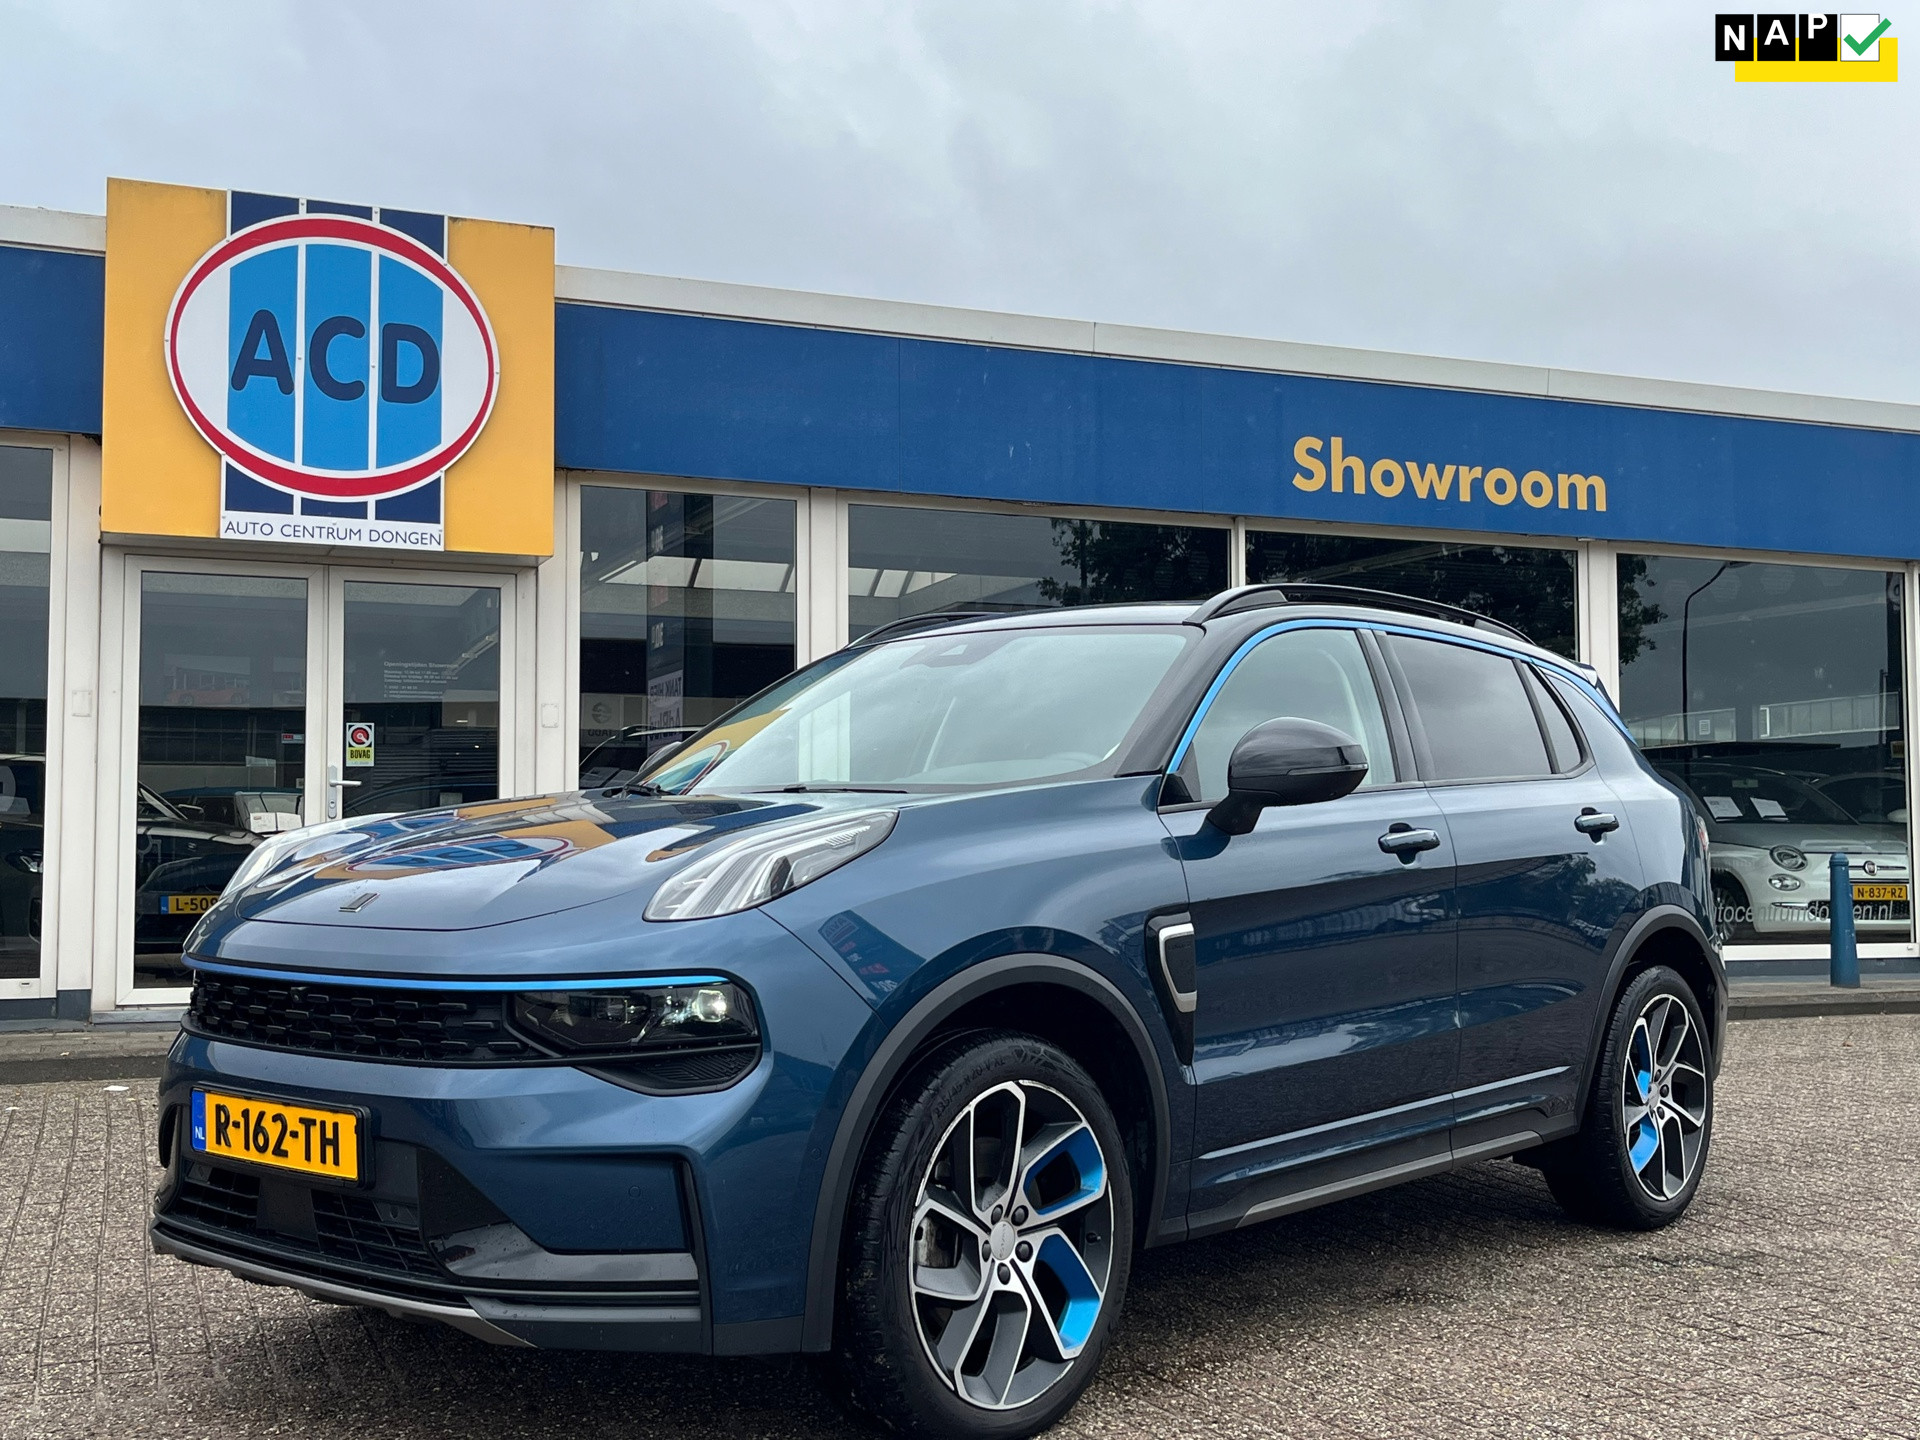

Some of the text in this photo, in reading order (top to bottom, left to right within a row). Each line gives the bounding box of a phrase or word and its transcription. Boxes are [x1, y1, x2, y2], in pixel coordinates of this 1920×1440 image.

[231, 309, 440, 404] ACD
[1292, 436, 1607, 512] Showroom
[225, 521, 442, 545] AUTO CENTRUM DONGEN
[350, 749, 371, 759] BOVAG
[1857, 887, 1904, 899] N-837-RZ
[194, 1102, 341, 1168] NL R-162-TH
